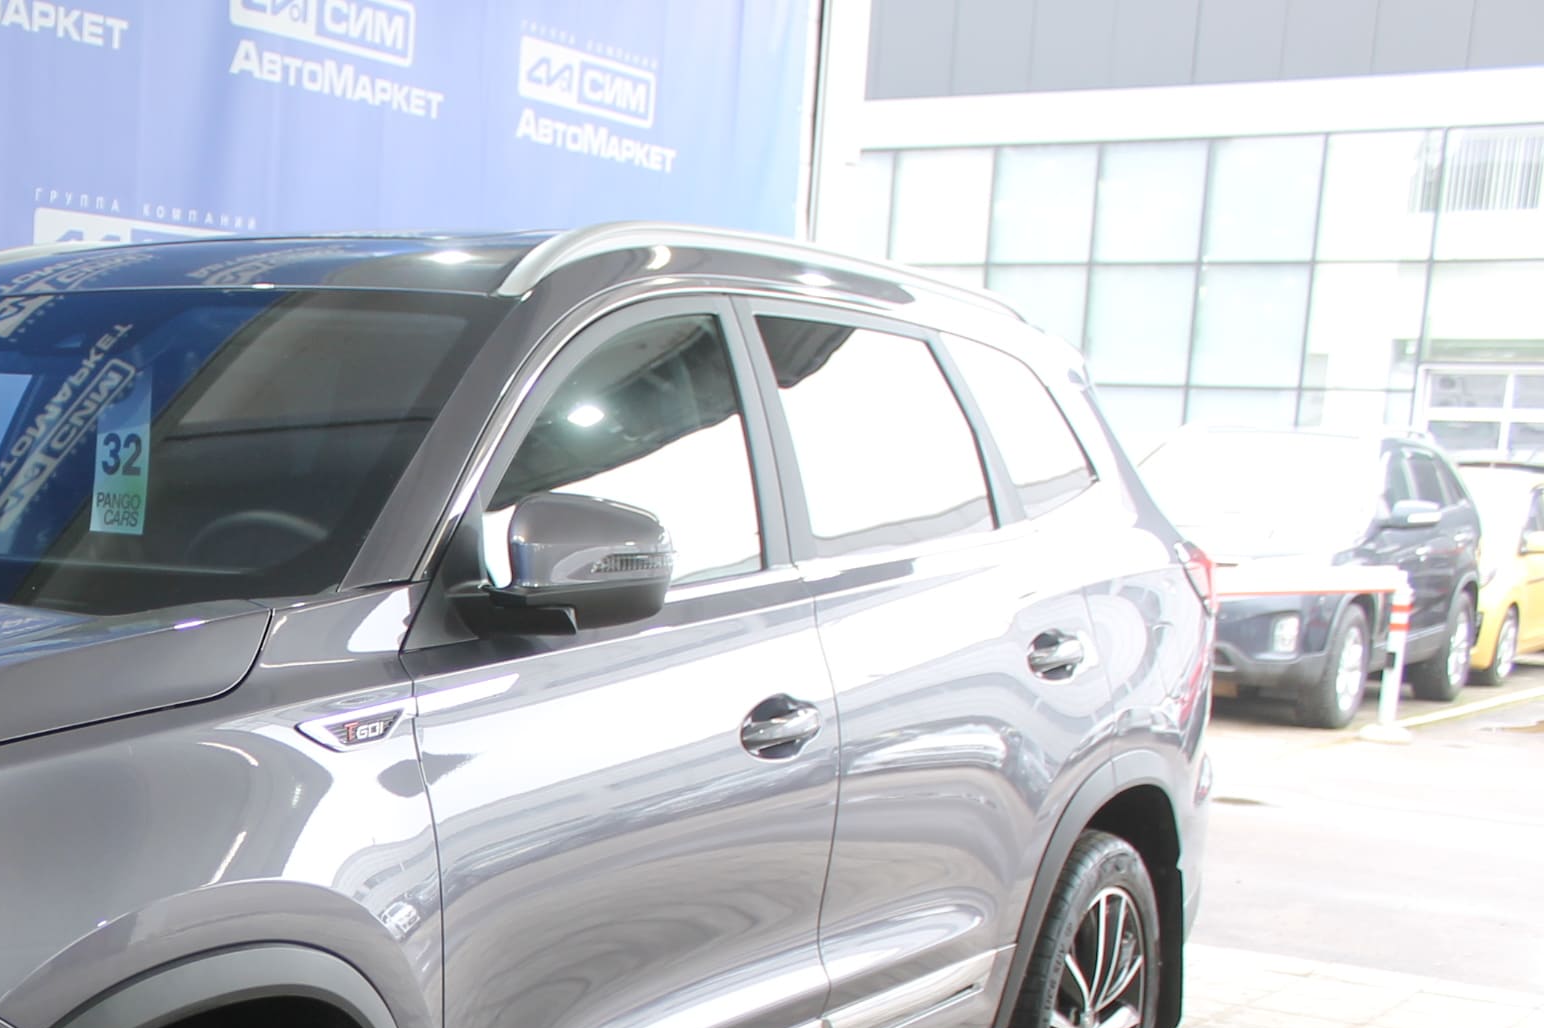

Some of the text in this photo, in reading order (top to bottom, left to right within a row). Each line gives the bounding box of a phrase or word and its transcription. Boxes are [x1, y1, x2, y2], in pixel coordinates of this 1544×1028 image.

[324, 1, 405, 50] СИМ
[583, 70, 648, 114] СИМ
[35, 187, 121, 213] ГРУППА
[101, 433, 143, 476] 32
[96, 492, 141, 509] PANGO
[103, 510, 139, 528] CARS
